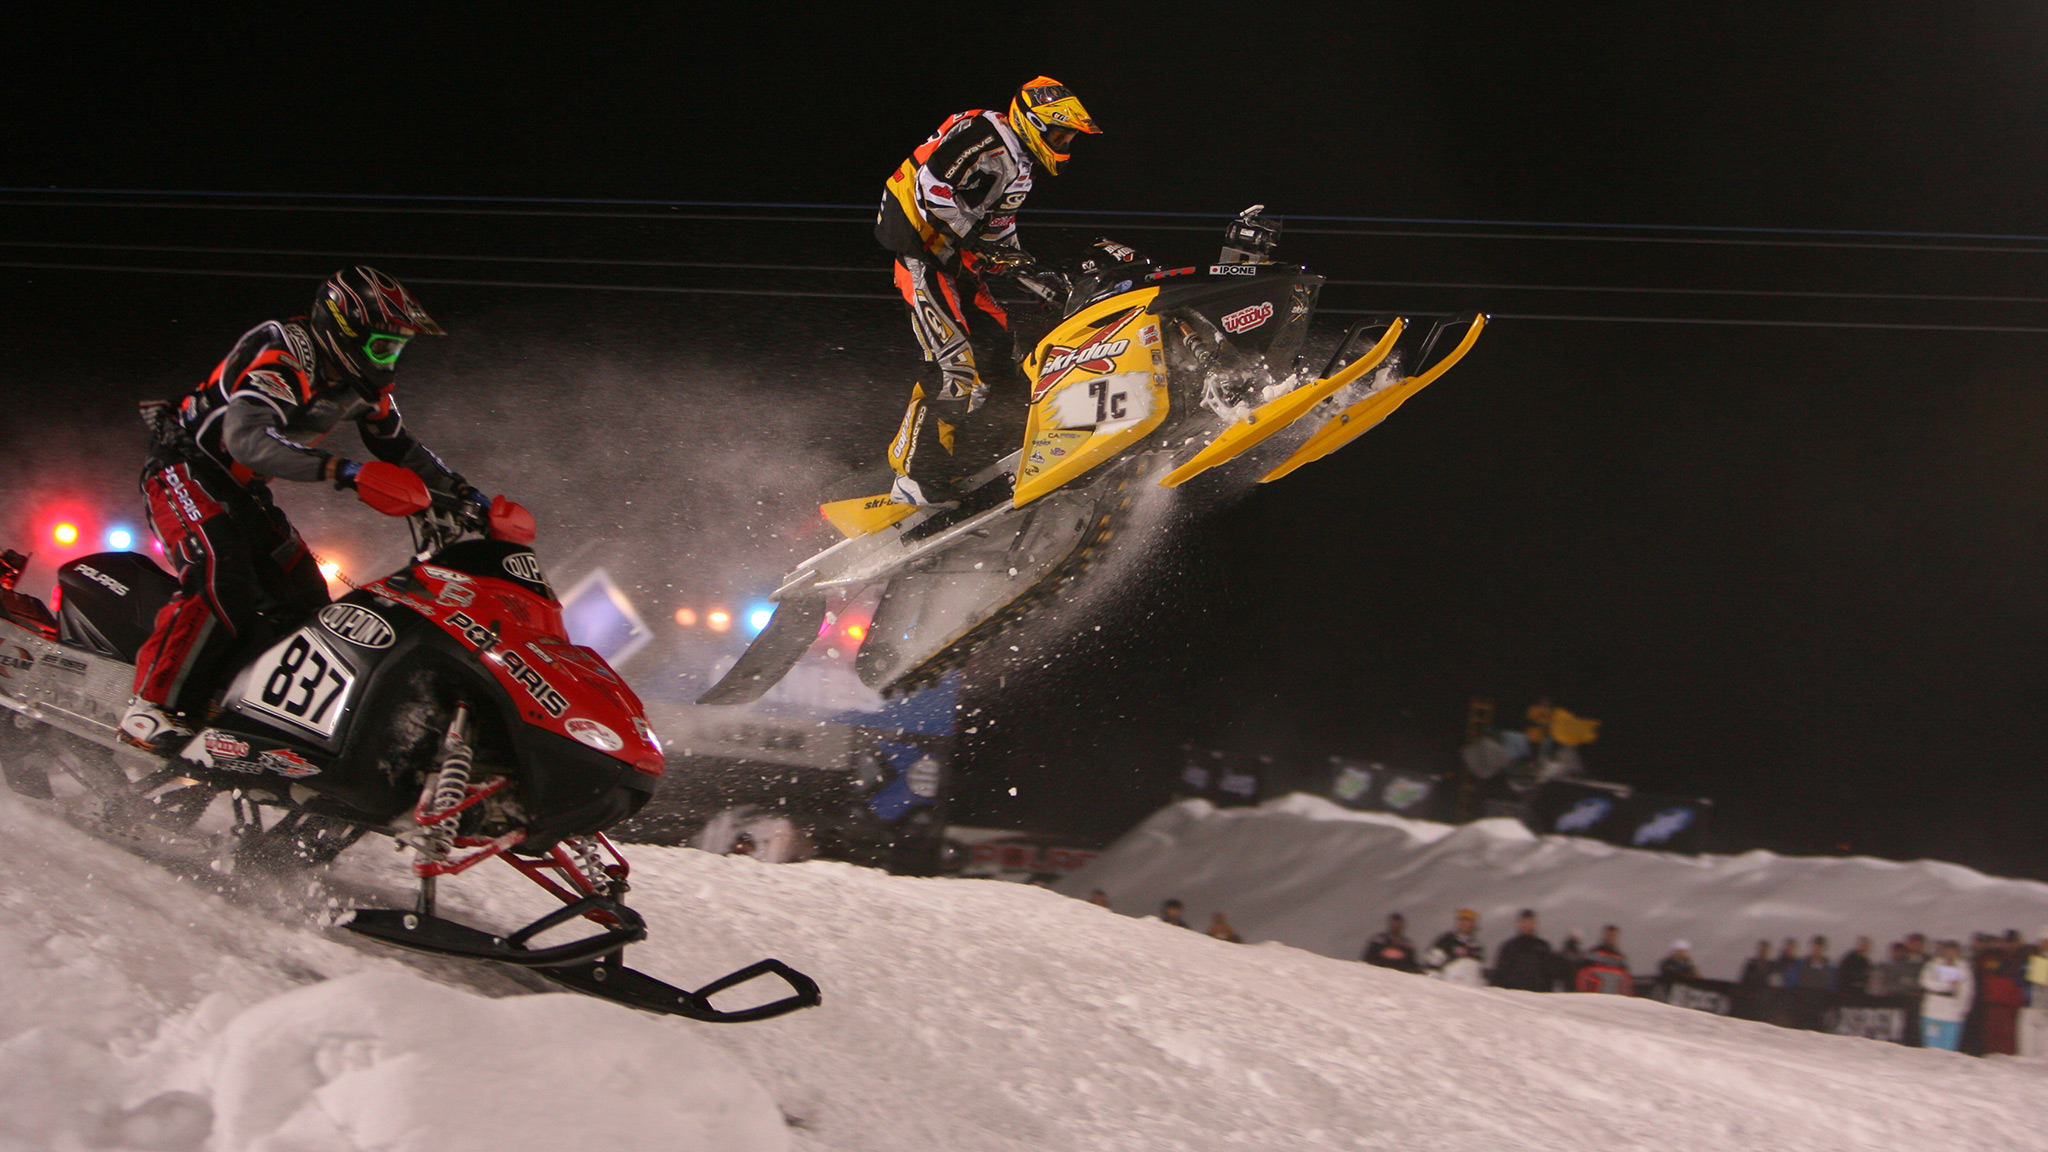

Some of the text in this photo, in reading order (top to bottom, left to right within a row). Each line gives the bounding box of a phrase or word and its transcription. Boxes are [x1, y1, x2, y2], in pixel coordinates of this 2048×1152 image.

[1220, 266, 1255, 274] IPONE
[73, 563, 130, 597] POLARIS
[508, 555, 543, 581] DUP
[322, 606, 391, 645] DUPONT
[262, 634, 347, 724] 837
[443, 611, 570, 719] POLARIS
